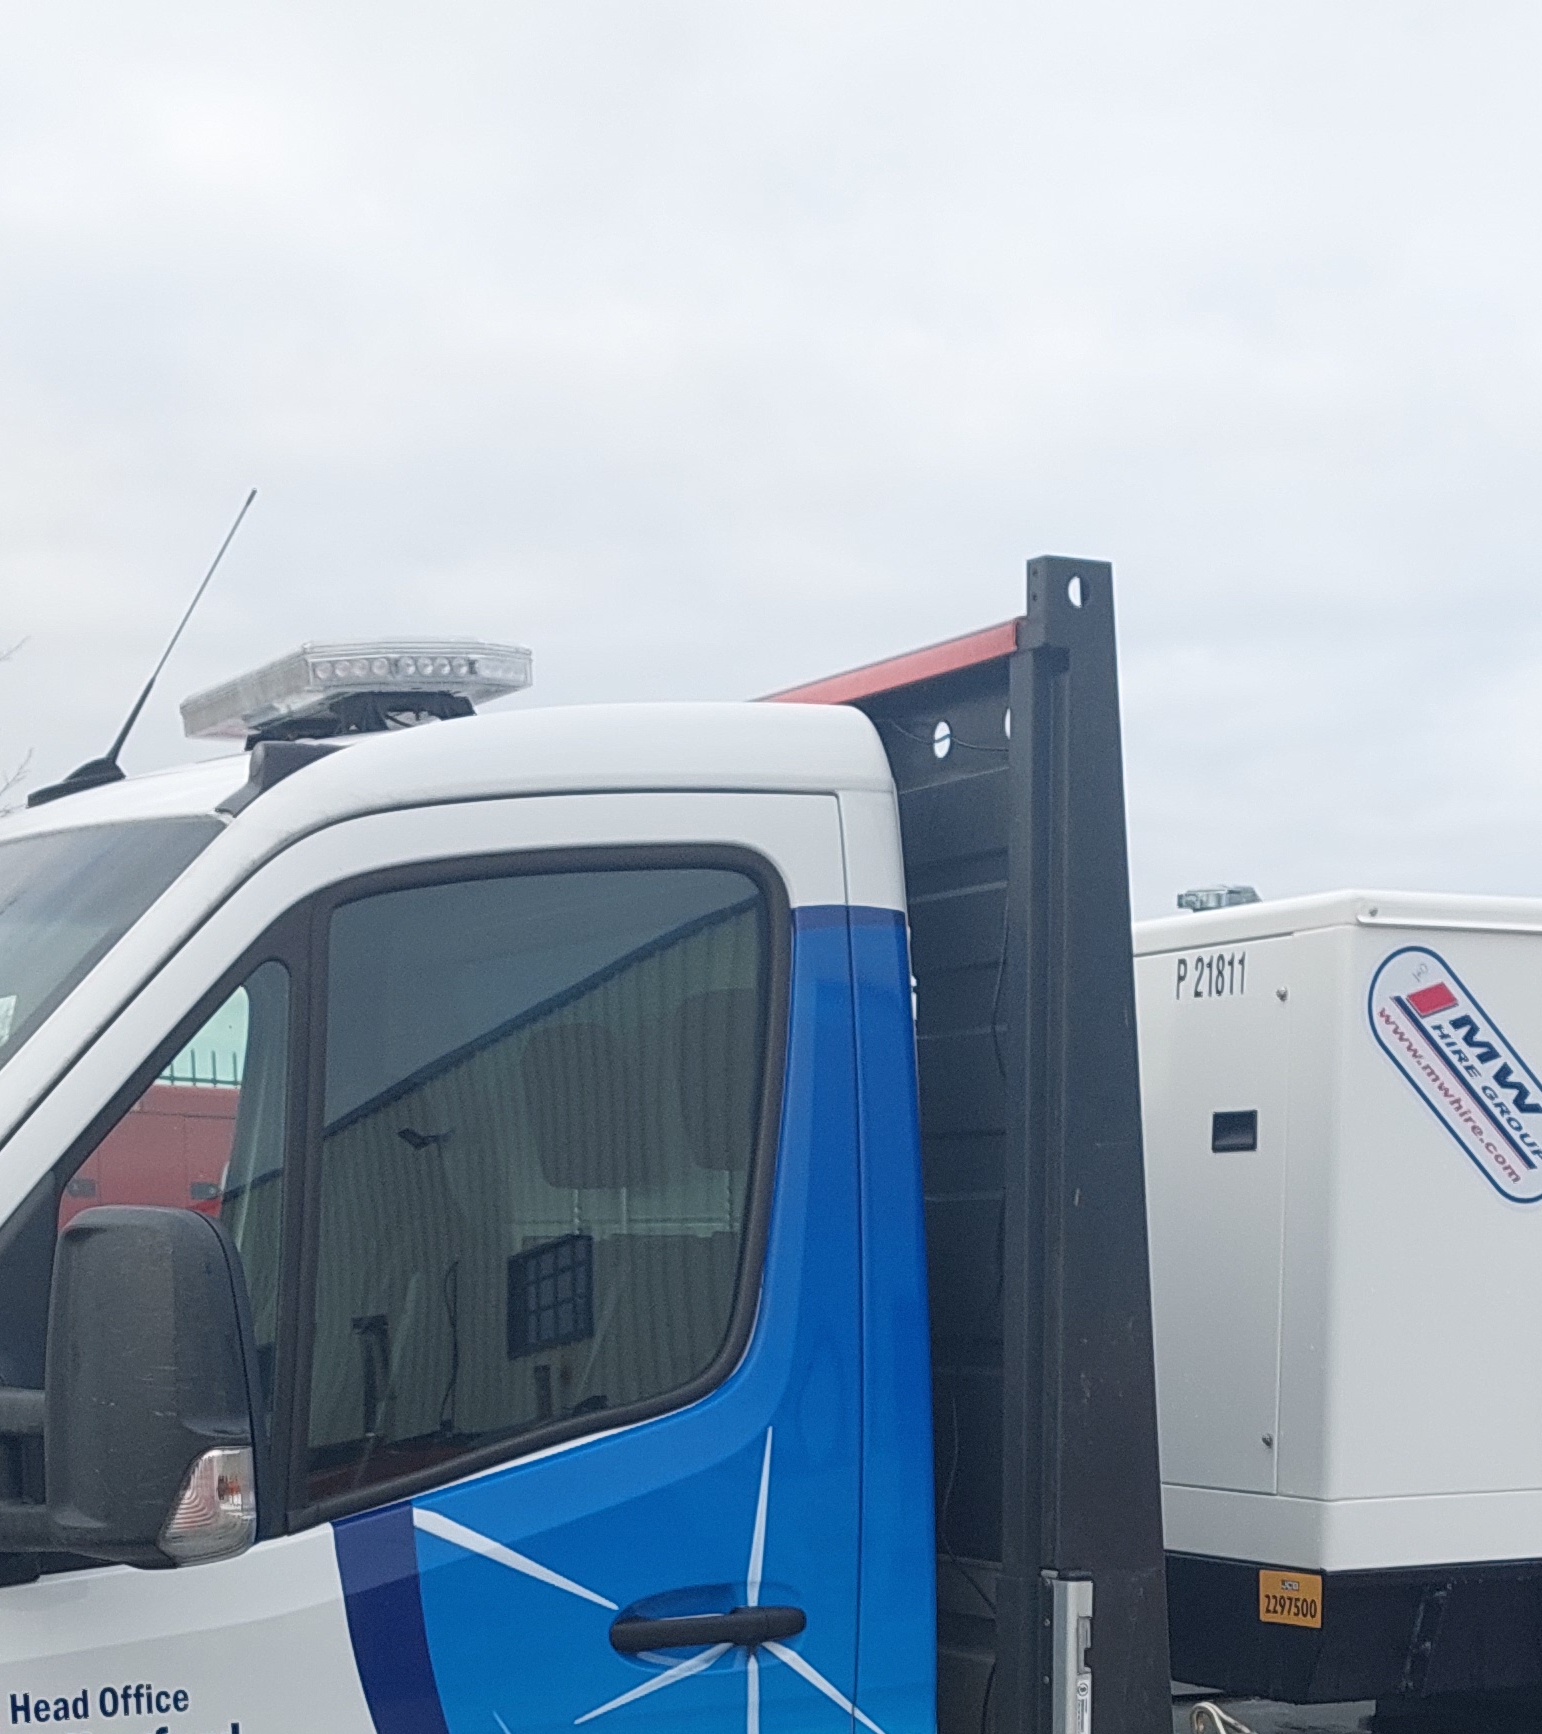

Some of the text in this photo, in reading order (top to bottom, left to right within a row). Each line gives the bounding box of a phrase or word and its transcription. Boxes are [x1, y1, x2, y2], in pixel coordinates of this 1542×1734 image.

[1175, 950, 1247, 1001] P 21811
[1430, 1024, 1482, 1079] HIRE
[1378, 1006, 1522, 1185] www.mwhire.com
[1264, 1593, 1318, 1619] 2297500
[9, 1683, 190, 1725] Head Office
